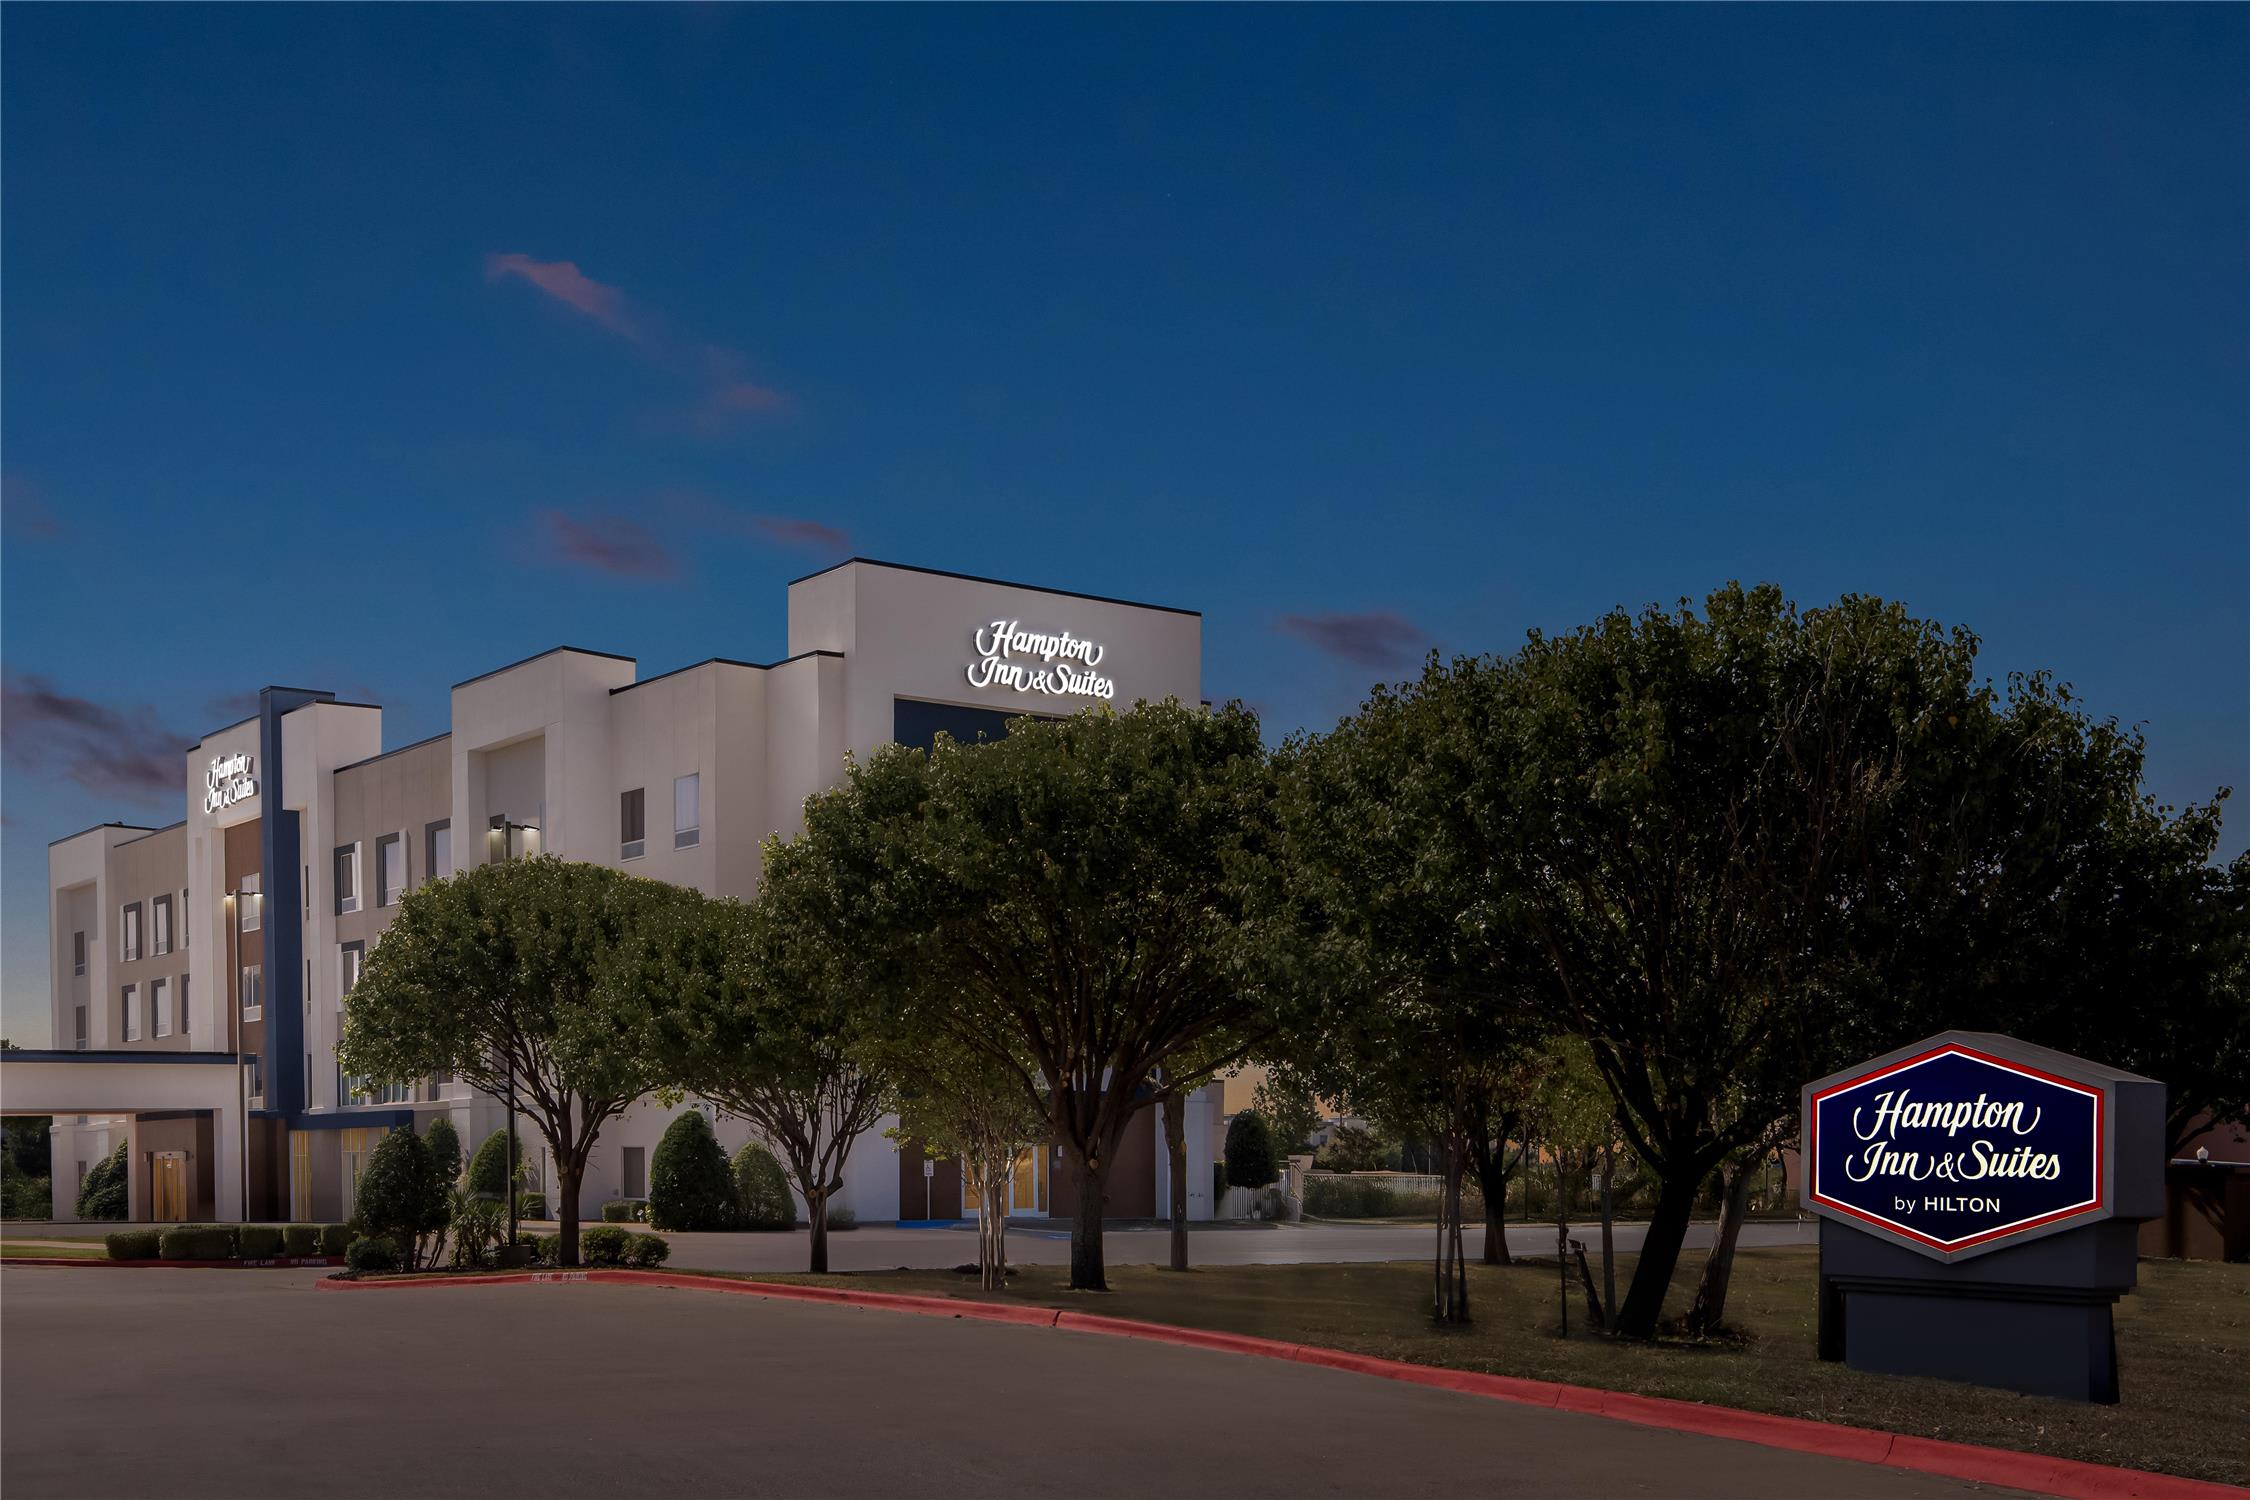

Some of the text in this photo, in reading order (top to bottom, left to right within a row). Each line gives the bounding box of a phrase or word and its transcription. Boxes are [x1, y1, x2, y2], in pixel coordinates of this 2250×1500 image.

[976, 620, 1103, 666] Hampton
[968, 656, 1114, 699] Inn & Suites
[207, 753, 250, 789] Hampton
[229, 777, 253, 802] Suites
[1853, 1088, 2041, 1140] Hampton
[1845, 1140, 2061, 1182] Inn & Suites
[1894, 1196, 2001, 1214] by HILTON
